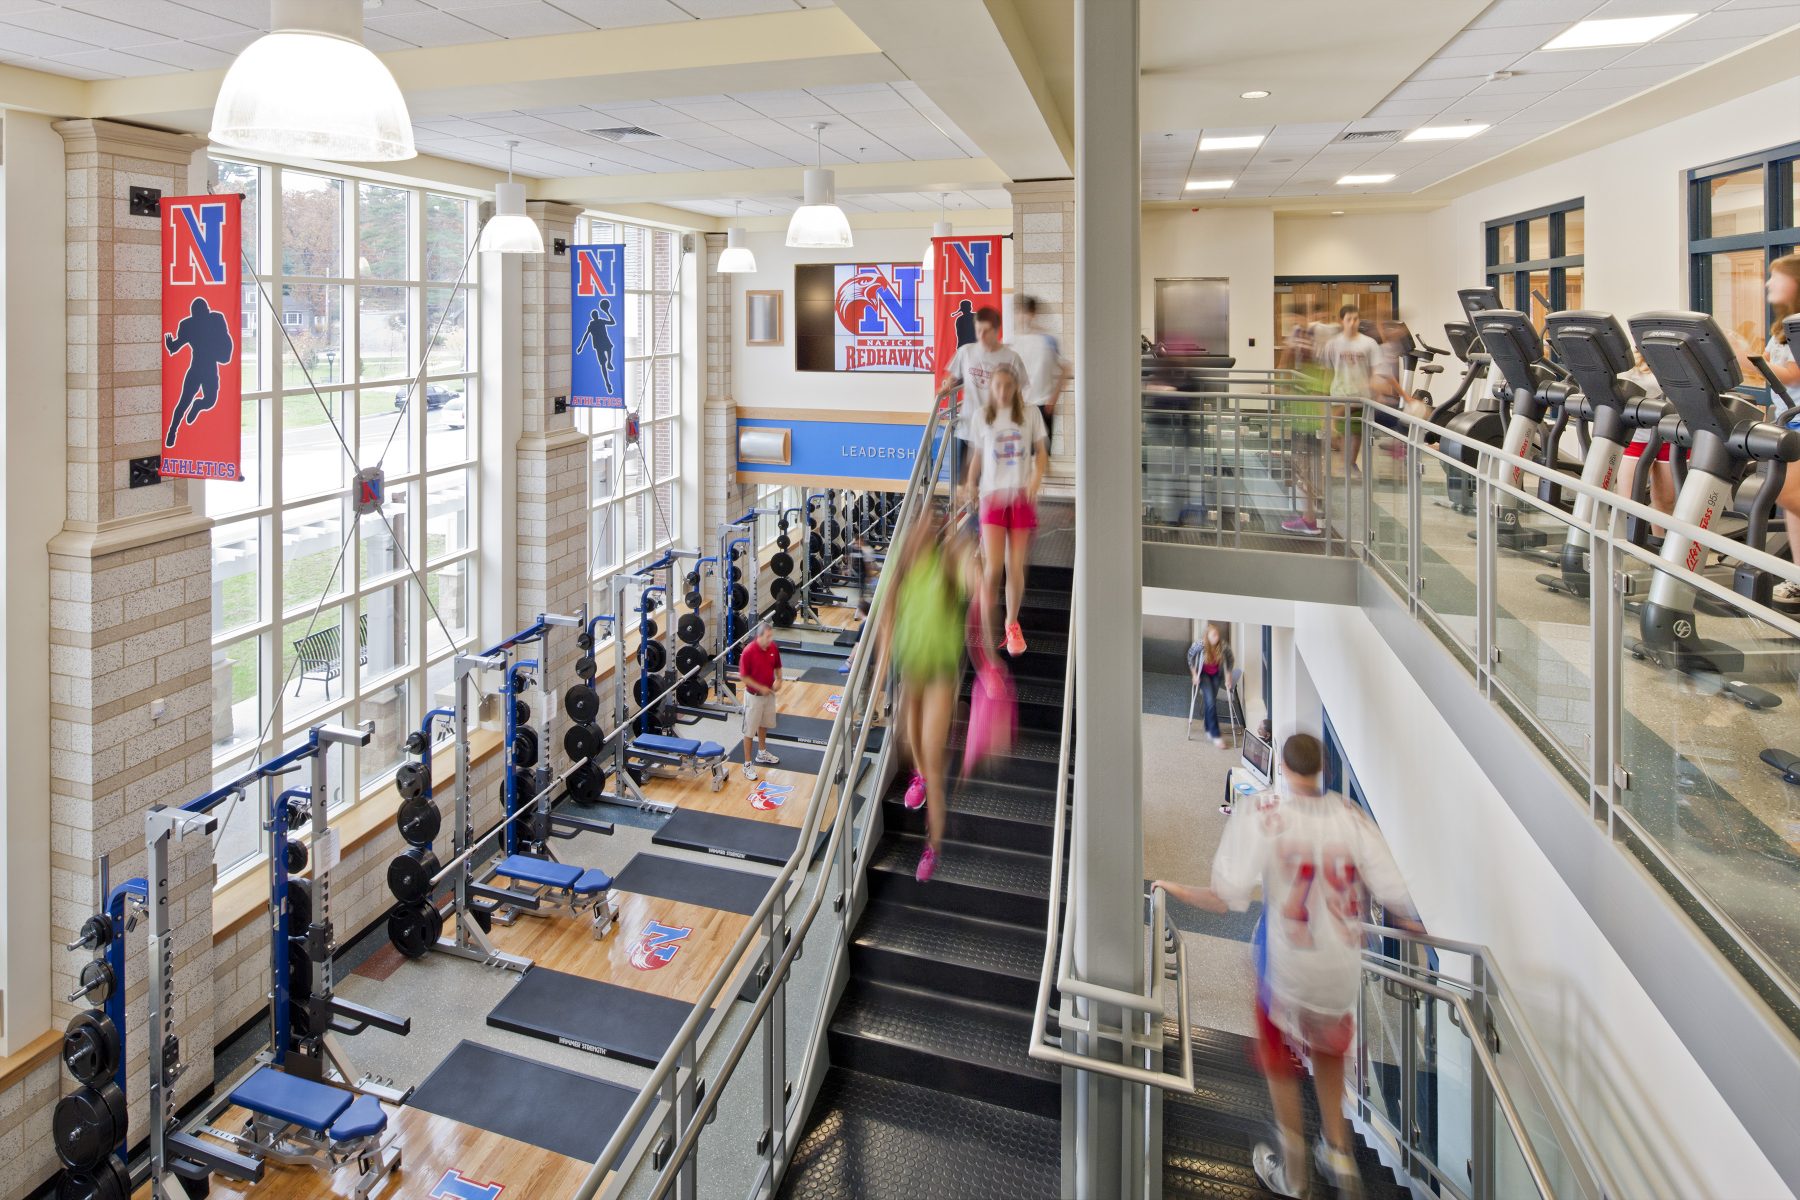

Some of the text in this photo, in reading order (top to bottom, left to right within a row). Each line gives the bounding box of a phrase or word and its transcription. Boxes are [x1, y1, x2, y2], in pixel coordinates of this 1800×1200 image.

[170, 203, 226, 285] N
[577, 249, 616, 296] N
[943, 241, 992, 294] N
[845, 345, 935, 371] REDHAWKS
[572, 395, 623, 407] ATHLETICS
[841, 445, 916, 459] LEADERSH
[162, 458, 235, 478] ATHLETICS
